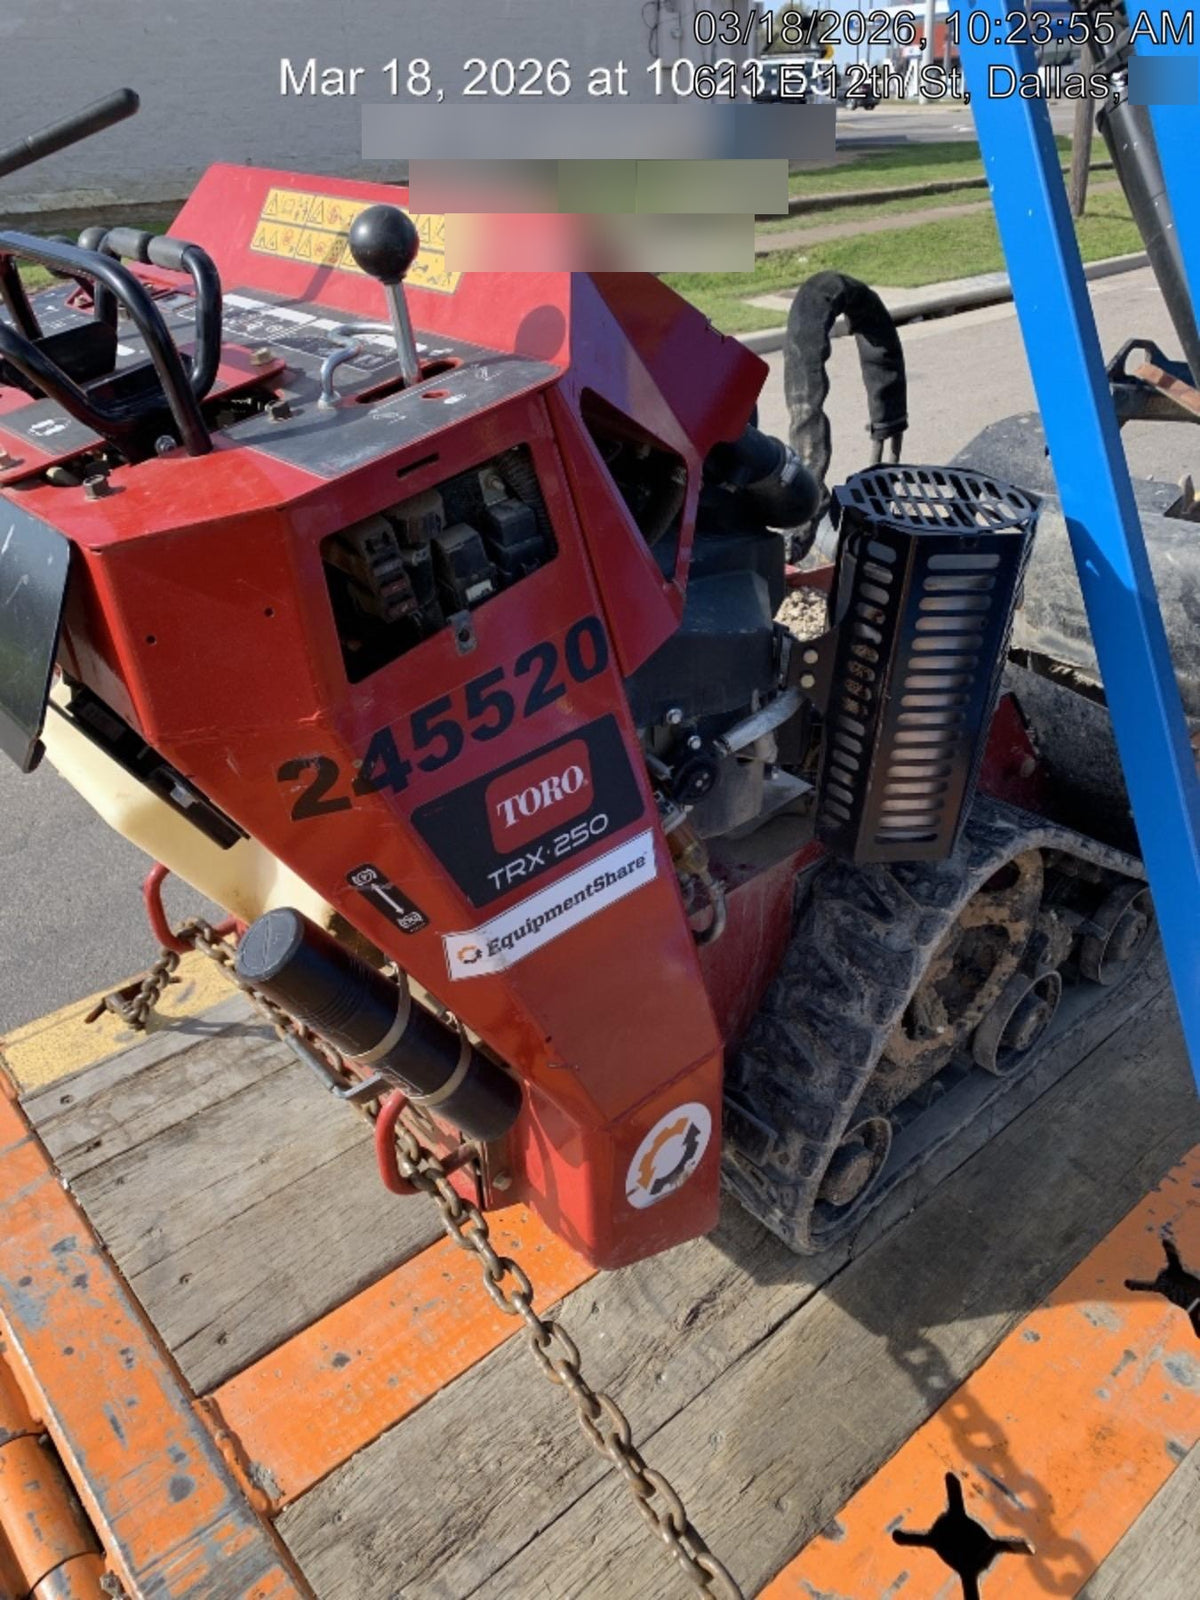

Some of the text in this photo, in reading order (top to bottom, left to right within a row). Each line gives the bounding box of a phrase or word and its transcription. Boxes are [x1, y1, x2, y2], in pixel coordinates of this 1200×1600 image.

[277, 616, 609, 822] 245520
[496, 765, 584, 829] TORO
[486, 852, 646, 957] EquipmentShare
